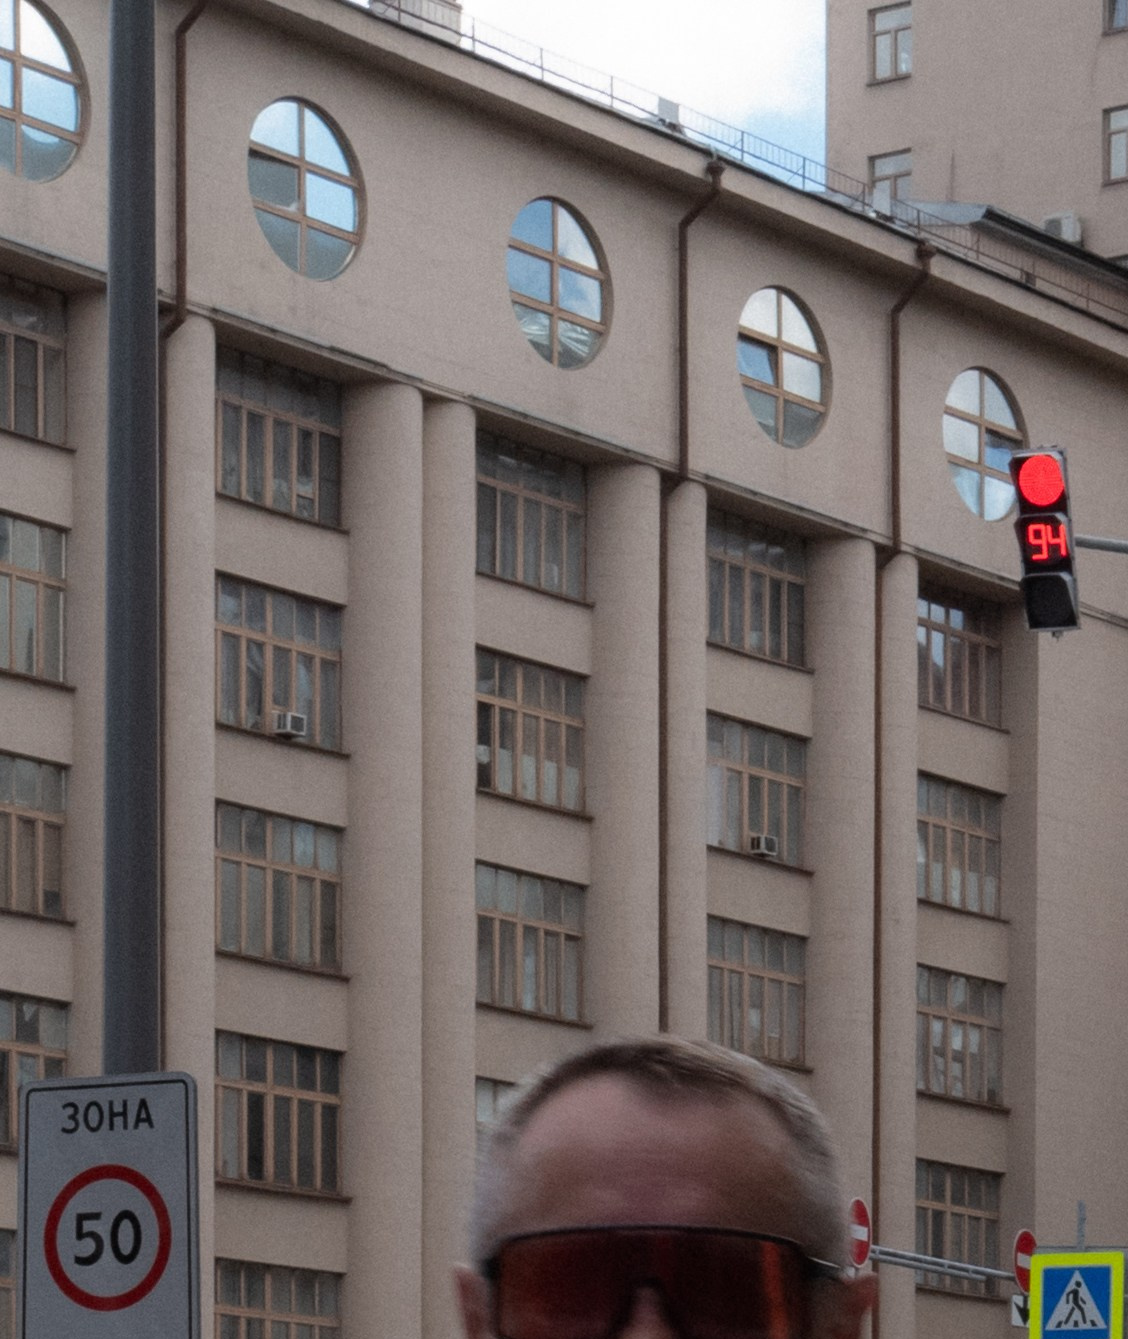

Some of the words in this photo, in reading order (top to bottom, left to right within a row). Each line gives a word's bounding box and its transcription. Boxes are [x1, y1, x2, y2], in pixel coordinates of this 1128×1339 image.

[1027, 523, 1068, 561] 94
[60, 1097, 155, 1134] ЗОНА
[73, 1209, 142, 1267] 50
